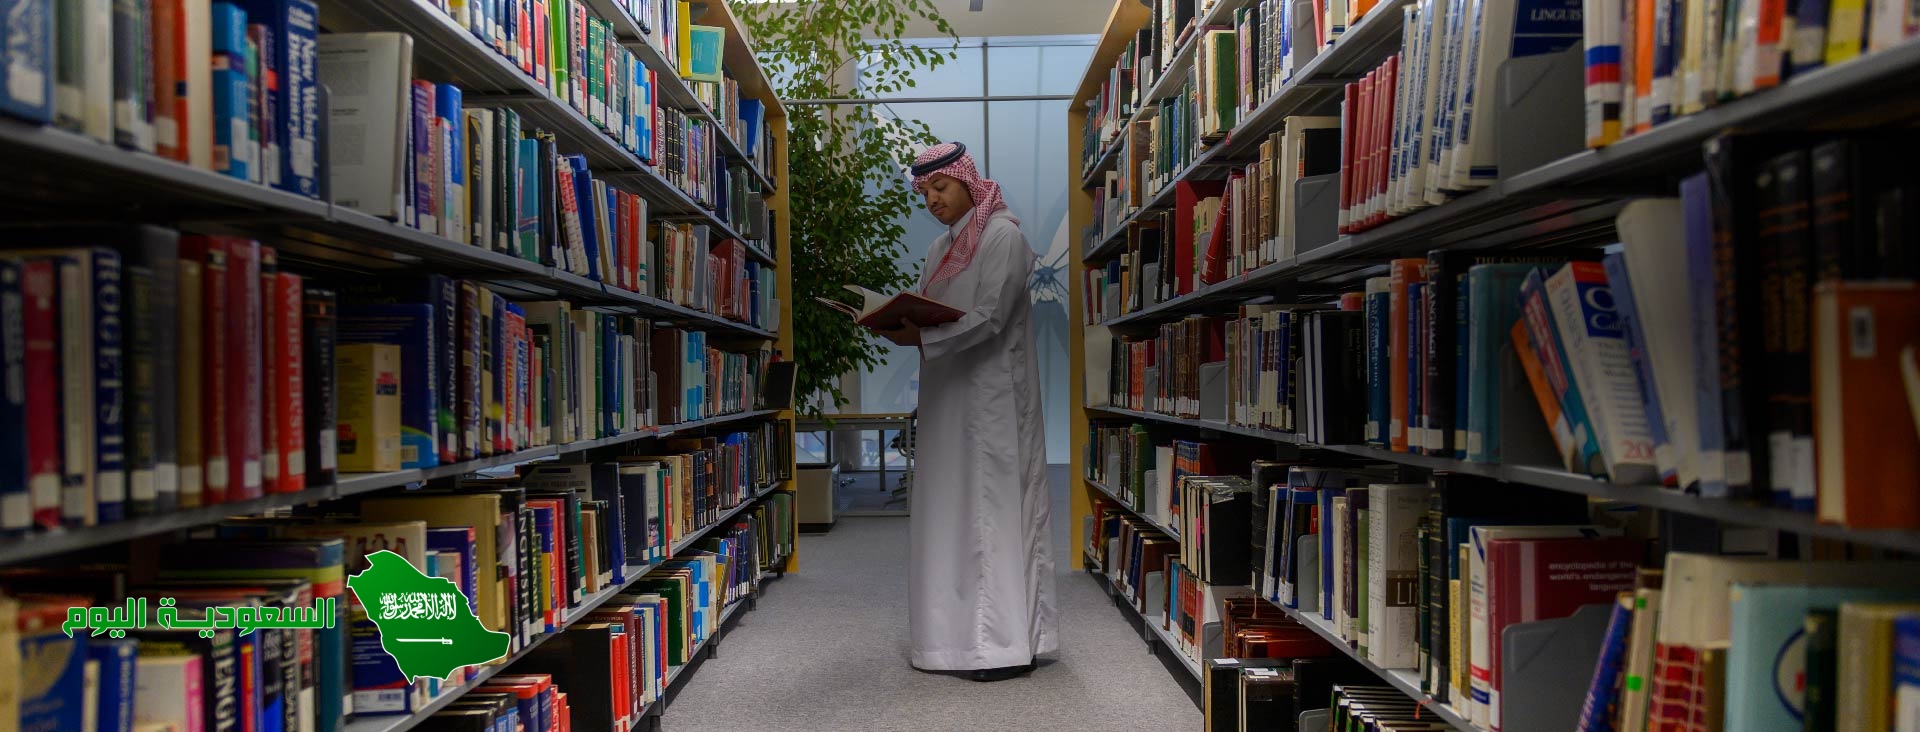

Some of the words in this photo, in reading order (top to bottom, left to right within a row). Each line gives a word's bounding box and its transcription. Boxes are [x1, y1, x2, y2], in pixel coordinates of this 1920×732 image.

[302, 37, 316, 81] New
[287, 31, 302, 139] Dictionary
[519, 504, 529, 610] ENGLISH
[1549, 561, 1607, 571] encyclopedia
[1549, 572, 1581, 581] world's
